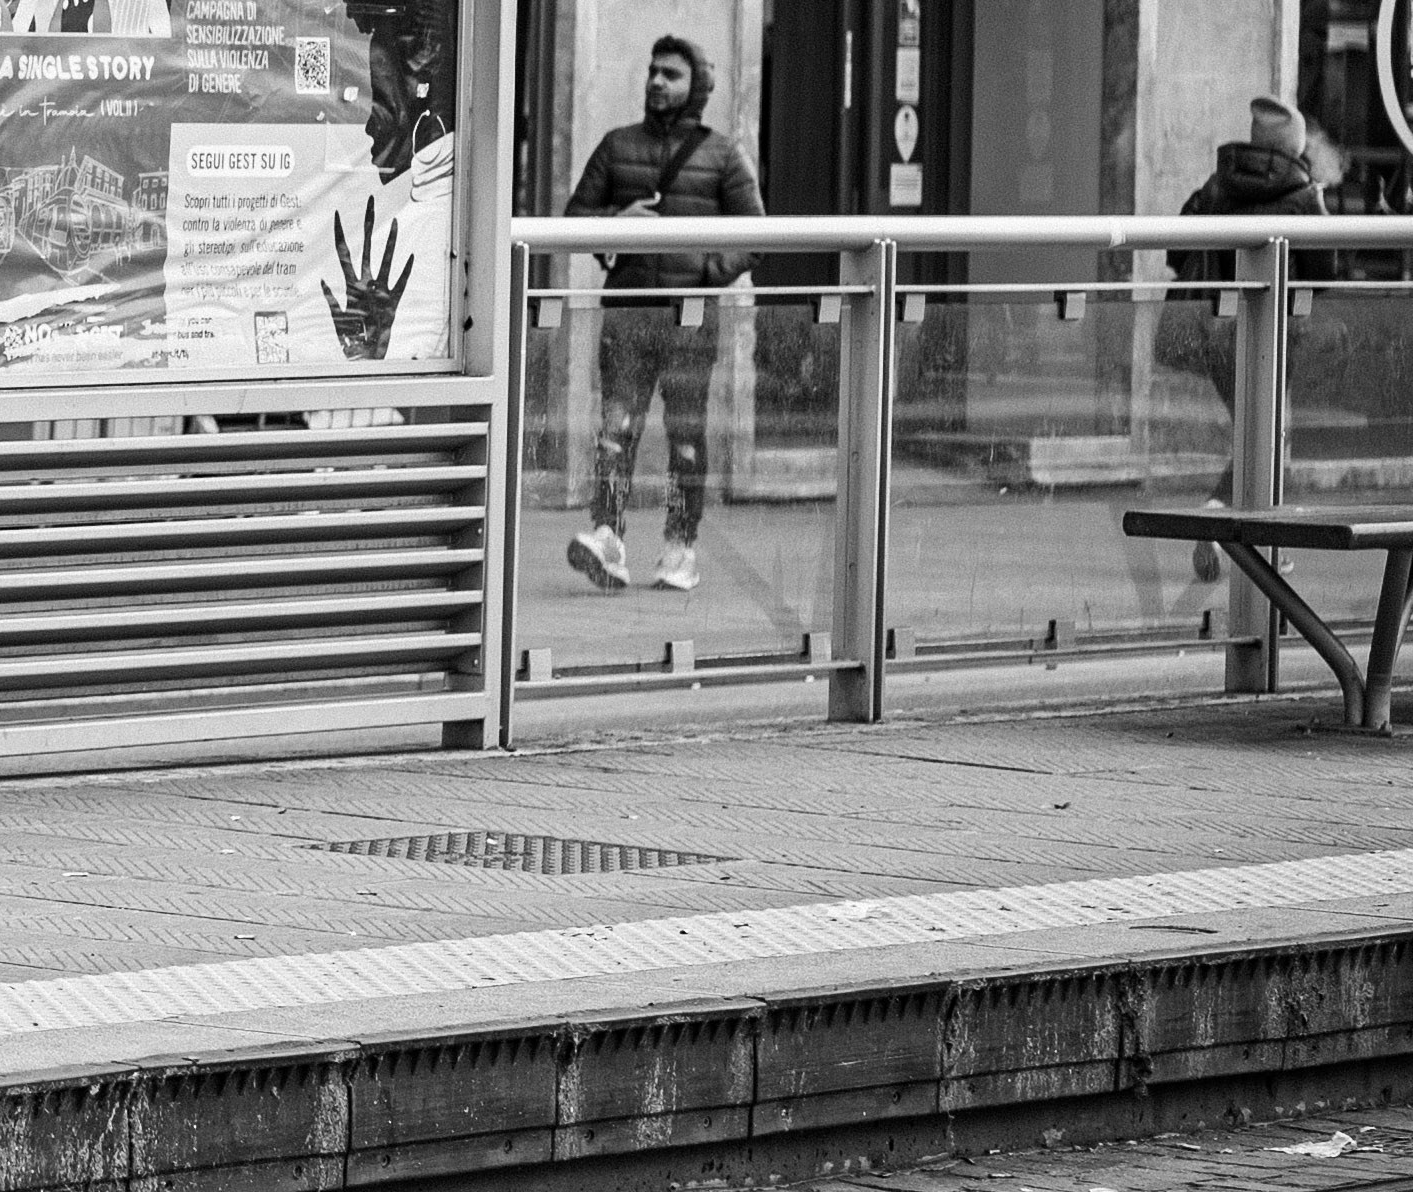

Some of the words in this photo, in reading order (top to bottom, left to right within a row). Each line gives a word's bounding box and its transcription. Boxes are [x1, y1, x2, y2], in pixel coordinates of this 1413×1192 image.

[186, 1, 244, 20] CAMPAGNA
[246, 1, 257, 20] DI
[186, 24, 286, 46] SENSIBILIZZAZIONE
[18, 54, 84, 80] SINGLE
[86, 55, 155, 81] STORY
[187, 49, 218, 68] SULLA
[219, 49, 269, 69] VIOLENZA
[188, 73, 199, 93] DI
[201, 73, 242, 94] GENERE
[191, 153, 225, 169] SEGUI
[229, 153, 257, 169] GEST
[261, 153, 276, 169] SU
[280, 153, 291, 169] IG
[184, 193, 210, 211] Scopri
[212, 194, 231, 209] tutti
[237, 194, 269, 211] progetti
[270, 194, 278, 209] di
[182, 216, 209, 232] contro
[212, 216, 220, 232] la
[223, 217, 256, 232] violenza
[276, 260, 297, 276] tram
